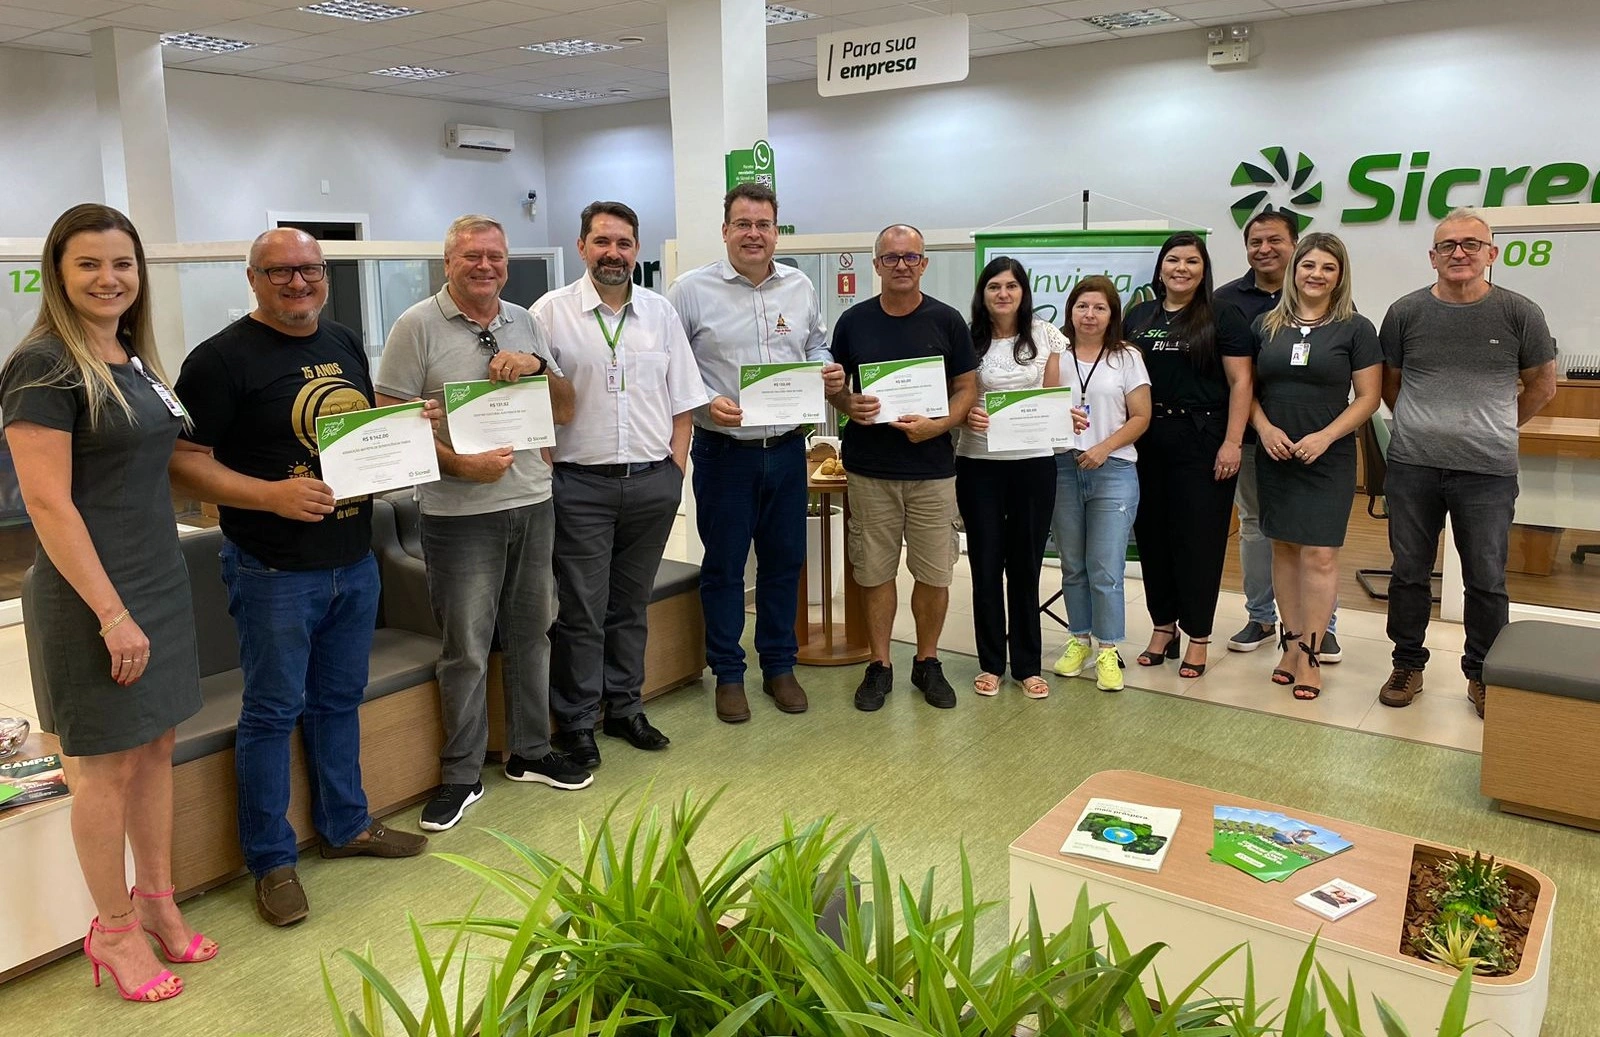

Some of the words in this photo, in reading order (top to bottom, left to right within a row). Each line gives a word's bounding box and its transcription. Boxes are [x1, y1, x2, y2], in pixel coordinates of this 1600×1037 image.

[843, 41, 881, 59] Para
[885, 36, 917, 53] sua
[840, 57, 917, 80] empresa
[1341, 151, 1600, 223] Sicre
[1503, 240, 1553, 267] 08
[9, 269, 41, 293] 12
[1027, 268, 1133, 293] Invita
[301, 366, 315, 379] 15
[314, 362, 343, 378] ANOS
[1, 755, 55, 770] CAMPO
